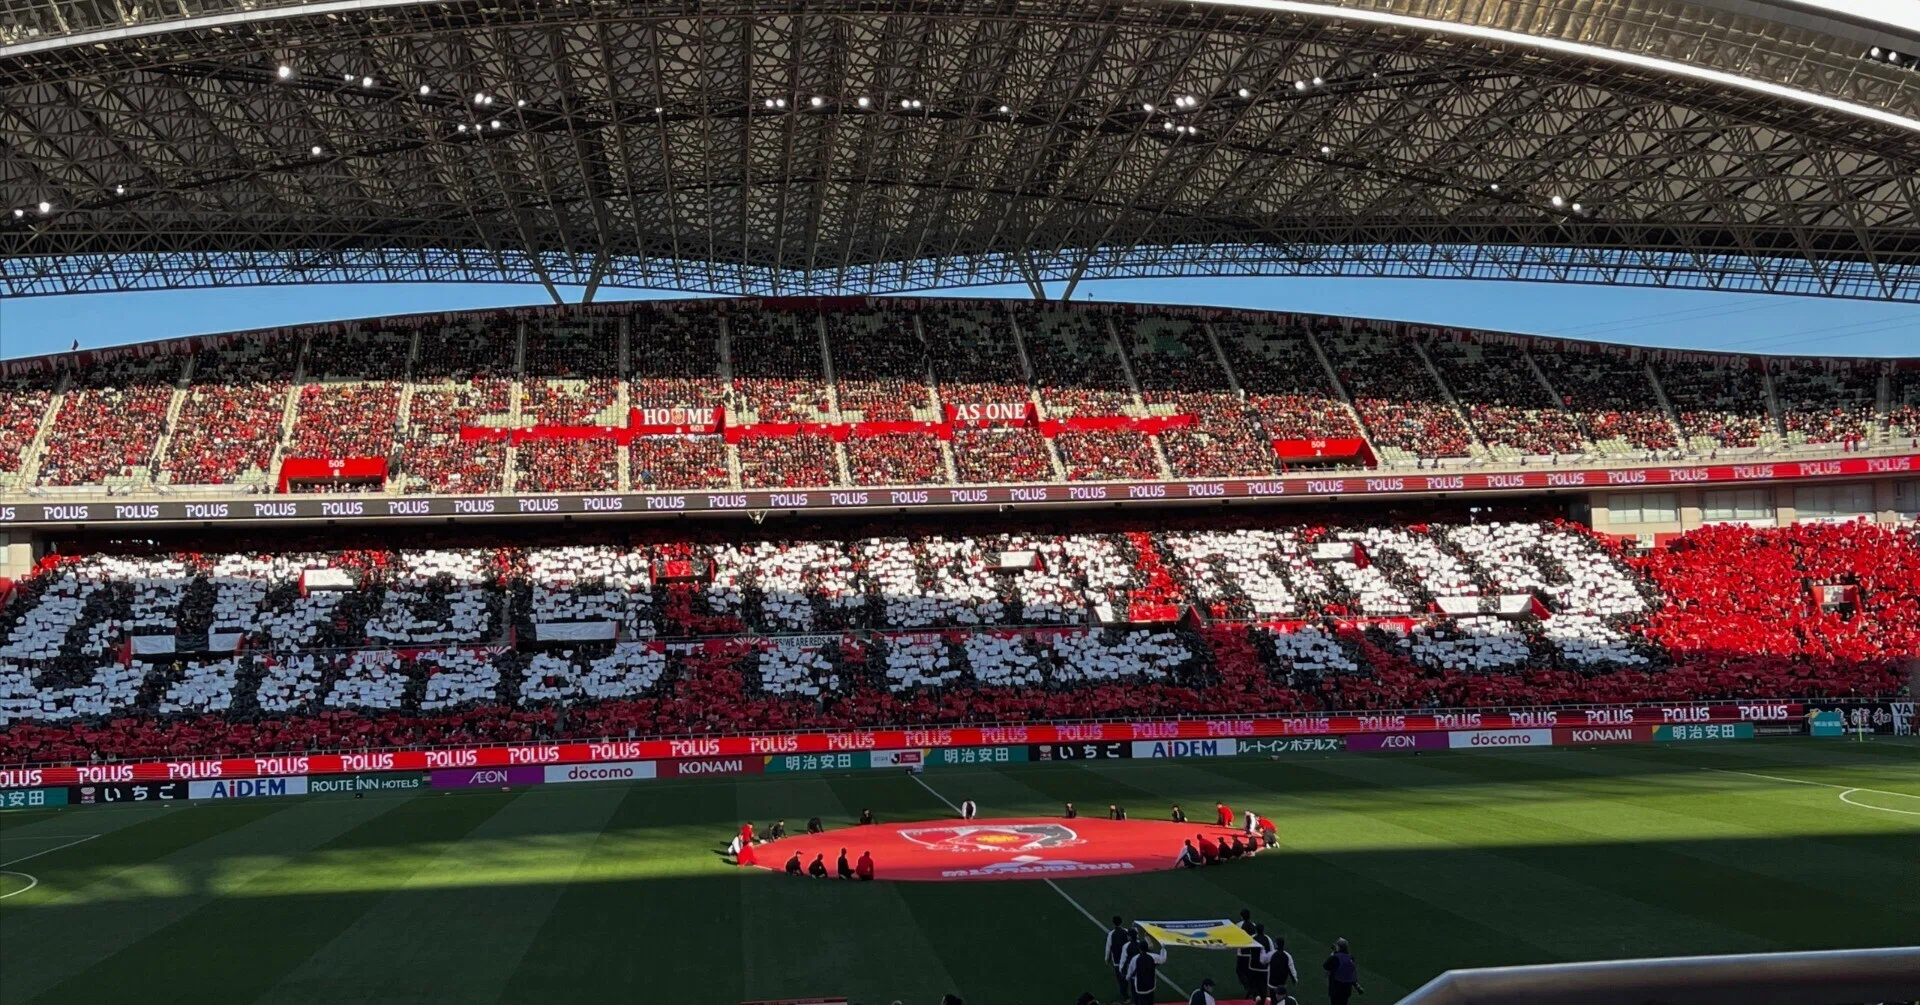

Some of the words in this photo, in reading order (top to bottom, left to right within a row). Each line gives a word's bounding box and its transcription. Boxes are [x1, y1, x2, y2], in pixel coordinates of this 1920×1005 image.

[955, 403, 980, 420] AS
[986, 403, 1025, 419] ONE
[328, 459, 345, 468] 505
[44, 506, 89, 519] POLUS
[116, 505, 160, 518] POLUS
[186, 504, 229, 517] POLUS
[255, 503, 297, 516] POLUS
[322, 502, 364, 515] POLUS
[389, 501, 430, 514] POLUS
[455, 500, 495, 513] POLUS
[520, 499, 560, 511] POLUS
[584, 498, 623, 510] POLUS
[647, 496, 686, 509] POLUS
[709, 495, 748, 507] POLUS
[771, 494, 808, 506] POLUS
[831, 492, 869, 505] POLUS
[891, 491, 929, 503] POLUS
[951, 490, 988, 502] POLUS
[1011, 488, 1048, 500] POLUS
[1070, 487, 1107, 499] POLUS
[1130, 485, 1166, 497] POLUS
[1188, 484, 1225, 496] POLUS
[1248, 481, 1284, 494] POLUS
[1307, 479, 1343, 492] POLUS
[1367, 478, 1403, 491] POLUS
[1427, 476, 1463, 489] POLUS
[1487, 474, 1524, 487] POLUS
[1547, 472, 1584, 485] POLUS
[1608, 470, 1646, 483] POLUS
[1670, 468, 1708, 481] POLUS
[1471, 732, 1531, 746] docomo
[1572, 729, 1632, 742] KONAMI
[1673, 724, 1735, 739] 明治安田
[0, 769, 42, 786] OLUS
[77, 765, 133, 784] POLUS
[167, 762, 222, 780] POLUS
[255, 757, 308, 775] POLUS
[341, 753, 394, 771] POLUS
[425, 750, 477, 768] POLUS
[509, 746, 560, 764] POLUS
[590, 743, 641, 760] POLUS
[671, 739, 720, 756] POLUS
[750, 736, 798, 753] POLUS
[828, 733, 876, 750] POLUS
[905, 731, 952, 746] POLUS
[982, 727, 1028, 743] POLUS
[1057, 725, 1103, 740] POLUS
[1133, 723, 1179, 738] POLUS
[1208, 721, 1254, 735] POLUS
[1283, 717, 1330, 733] POLUS
[1358, 715, 1405, 731] POLUS
[1433, 713, 1482, 729] POLUS
[1509, 711, 1557, 727] POLUS
[1585, 709, 1633, 724] POLUS
[1662, 706, 1710, 722] POLUS
[1738, 704, 1788, 720] POLUS
[1059, 743, 1120, 759] いちご
[1238, 738, 1338, 753] ルートインホテルズ
[786, 753, 851, 771] 明治安田
[944, 747, 1009, 763] 明治安田
[568, 766, 633, 780] docomo
[679, 759, 742, 774] KONAMI
[105, 784, 175, 802] いちご
[312, 779, 353, 792] ROUTE
[381, 779, 419, 789] HOTELS
[0, 791, 44, 806] 安田
